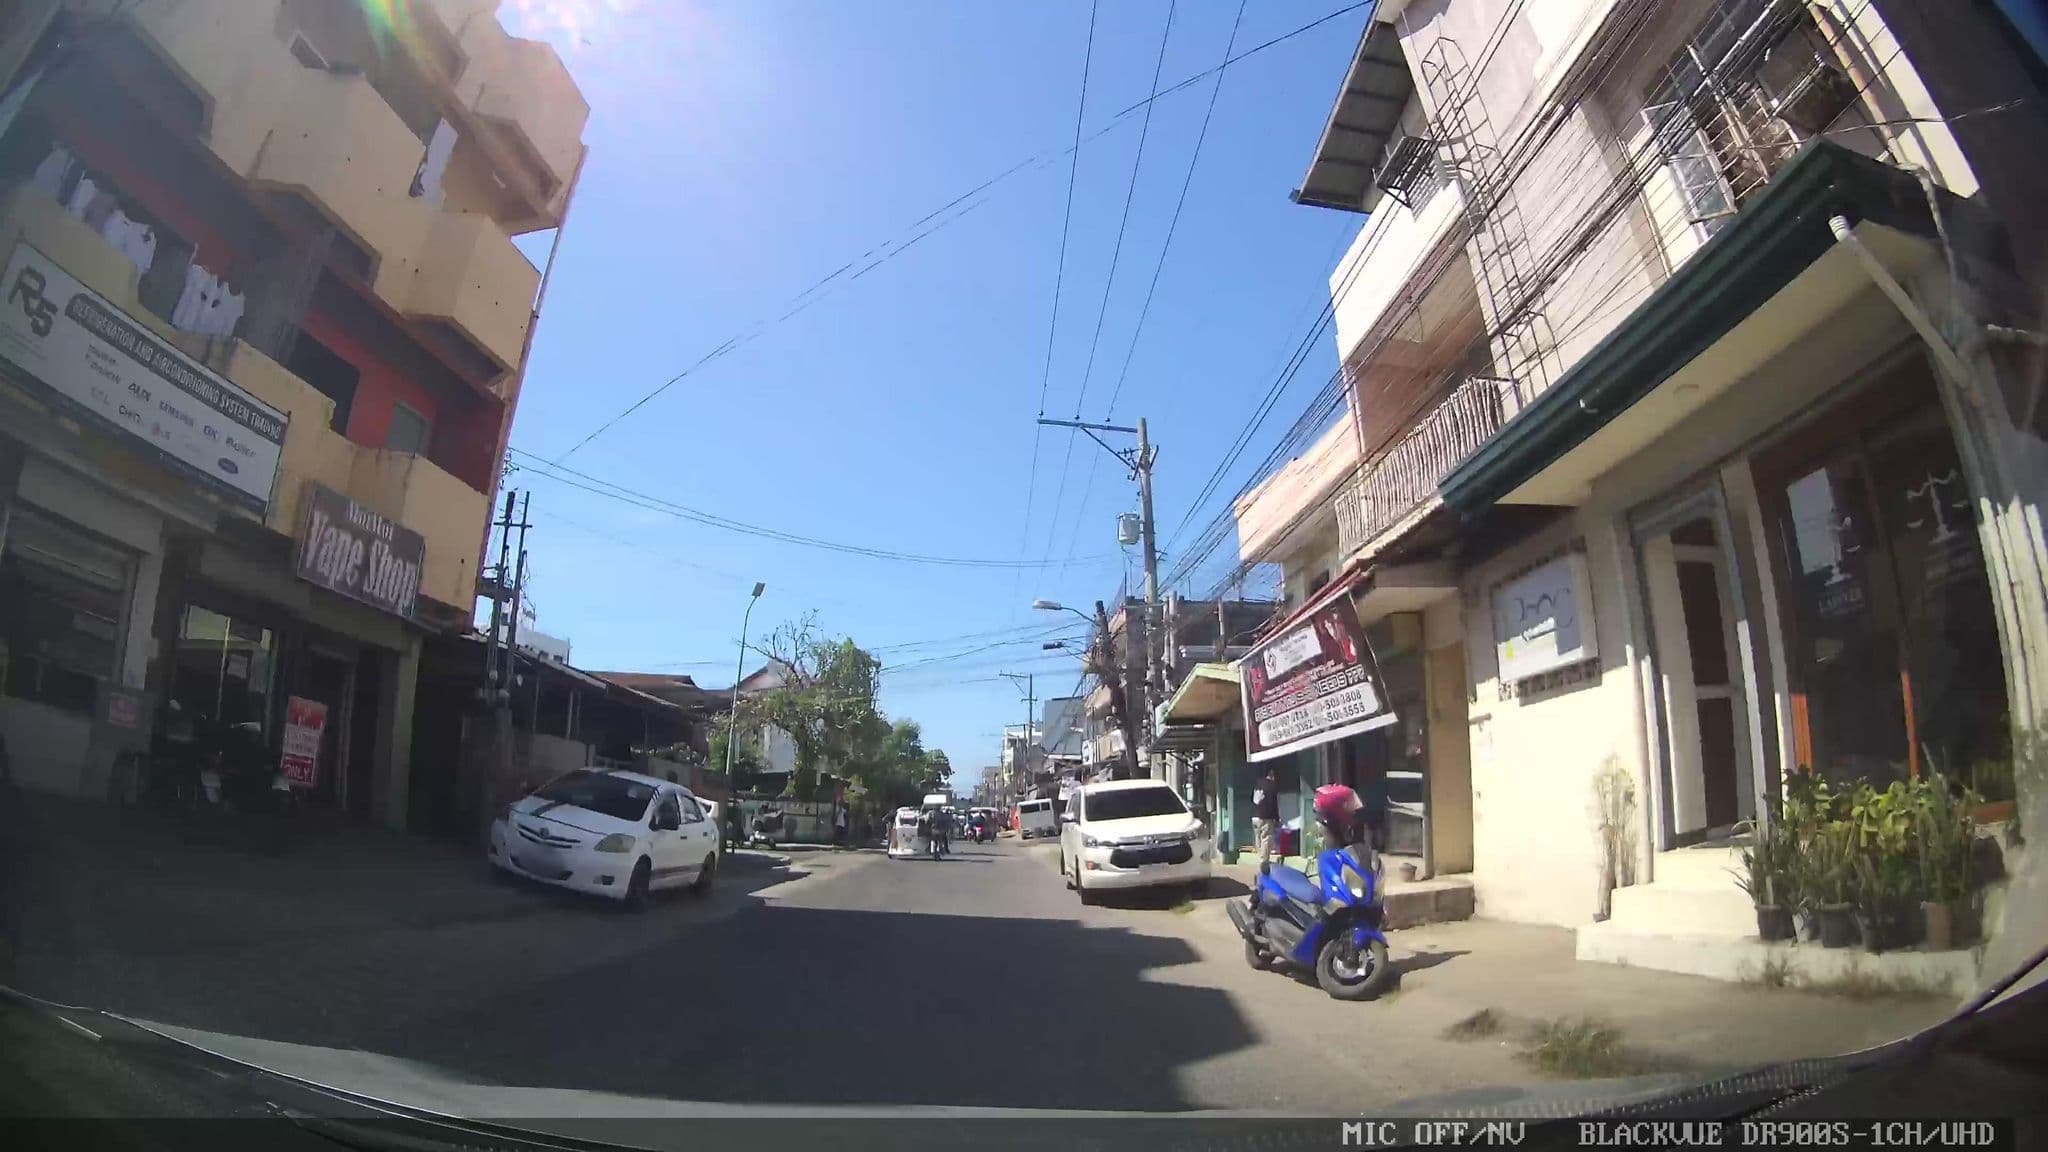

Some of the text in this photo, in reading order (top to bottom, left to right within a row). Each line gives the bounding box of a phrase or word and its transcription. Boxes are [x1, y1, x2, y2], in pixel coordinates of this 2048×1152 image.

[135, 341, 154, 362] AND
[220, 394, 250, 422] SYSTEM
[250, 411, 282, 441] TRADING
[306, 510, 417, 616] Vape Shop
